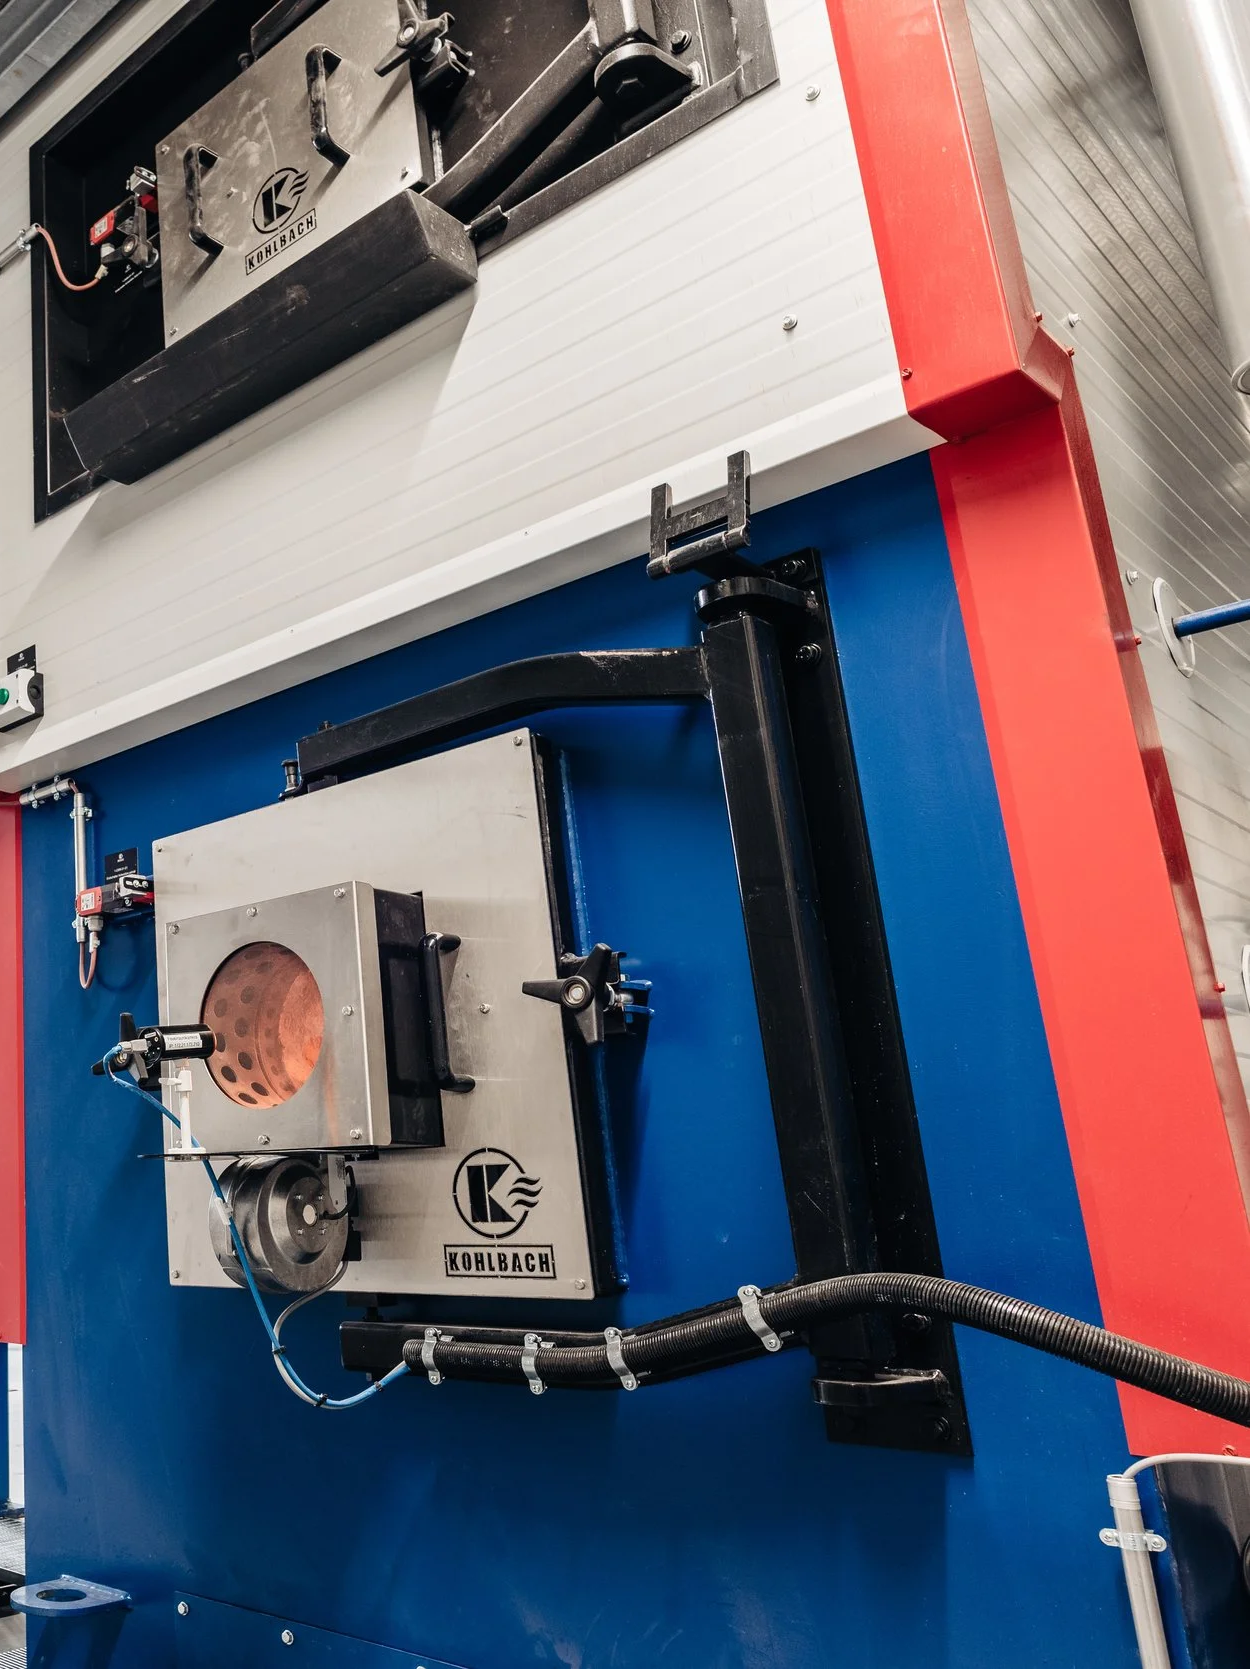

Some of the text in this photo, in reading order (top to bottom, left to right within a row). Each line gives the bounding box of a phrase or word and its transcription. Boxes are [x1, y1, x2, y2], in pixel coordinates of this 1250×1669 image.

[262, 174, 292, 228] K
[248, 216, 314, 270] KOHLBACH
[467, 1164, 516, 1222] K
[448, 1251, 550, 1272] KOHLBACH
